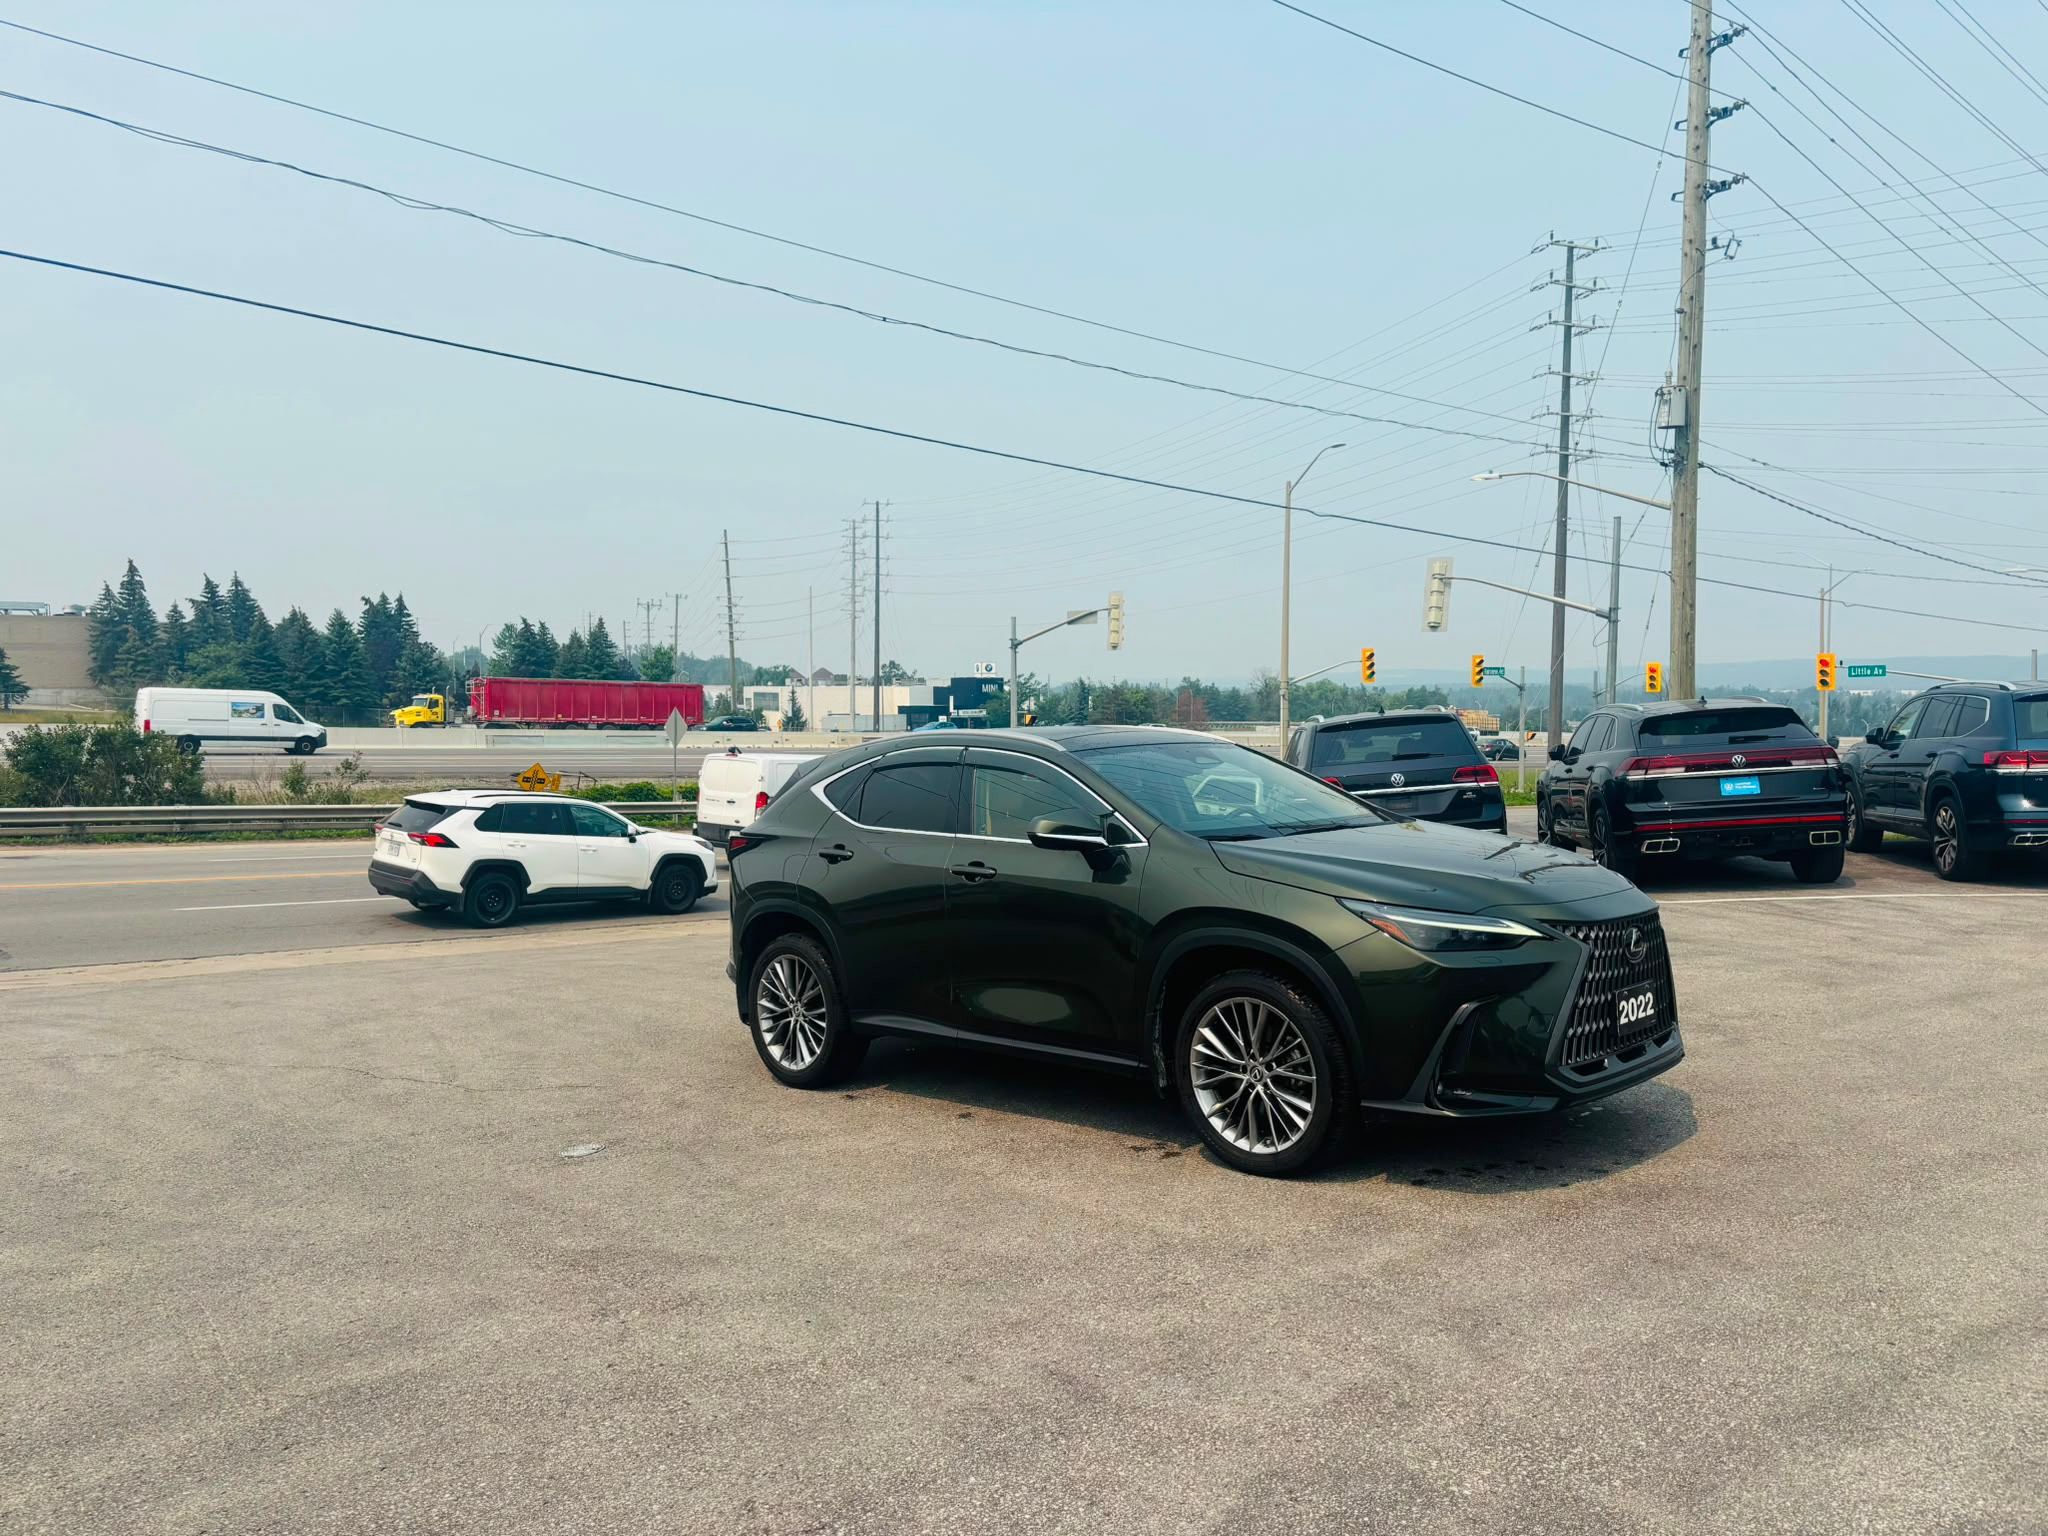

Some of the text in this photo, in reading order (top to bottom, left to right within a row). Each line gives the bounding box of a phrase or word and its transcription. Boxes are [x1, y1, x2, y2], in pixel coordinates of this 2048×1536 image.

[1851, 666, 1883, 676] Little Av
[981, 683, 999, 693] MINI
[1619, 991, 1655, 1025] 2022
